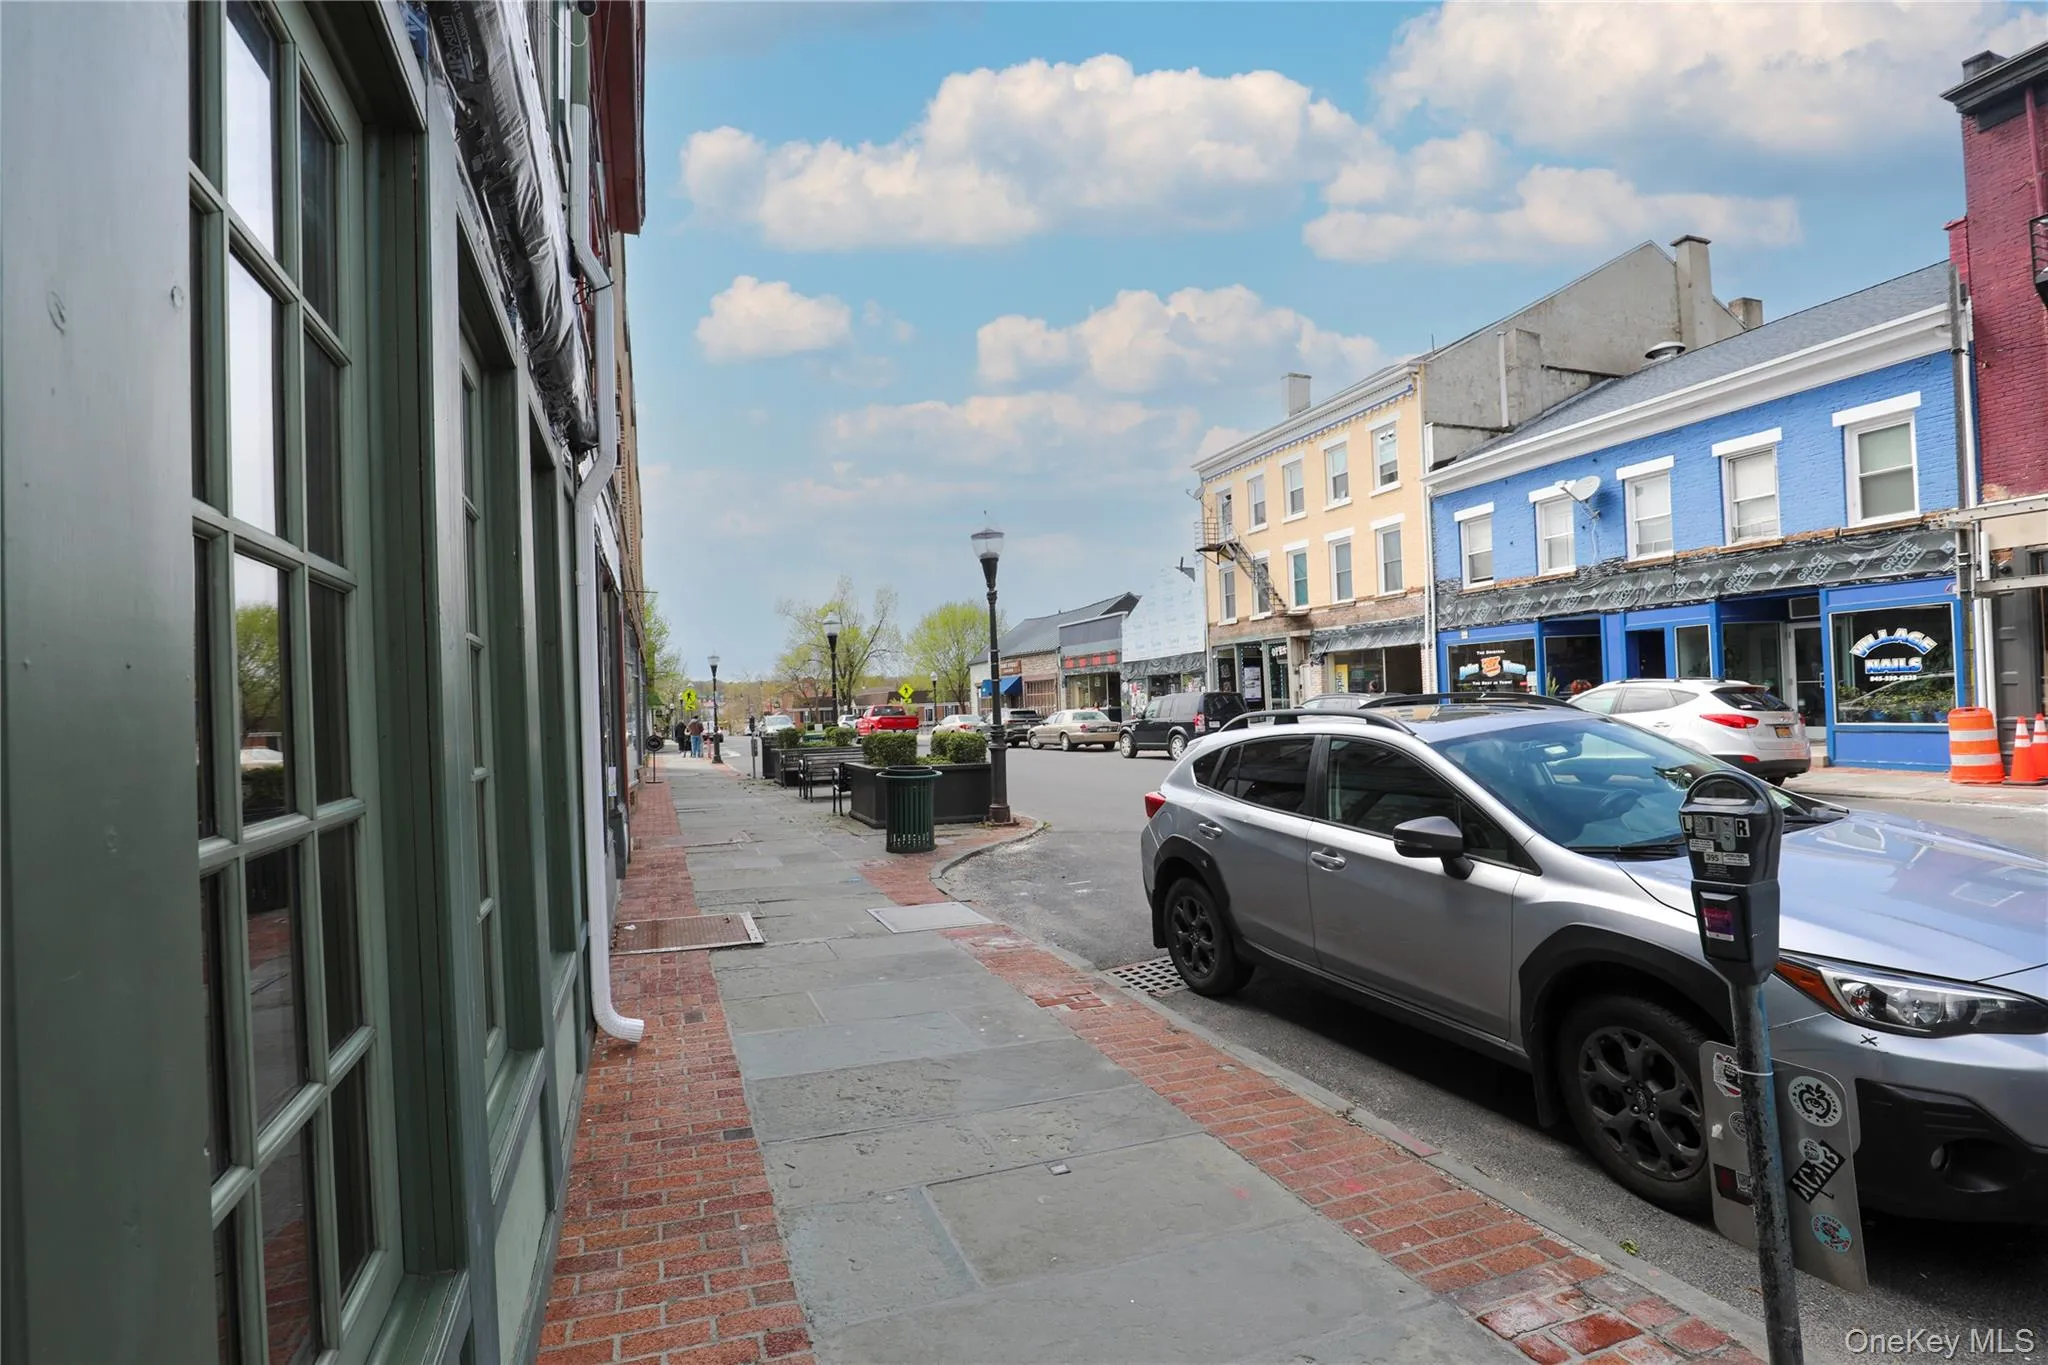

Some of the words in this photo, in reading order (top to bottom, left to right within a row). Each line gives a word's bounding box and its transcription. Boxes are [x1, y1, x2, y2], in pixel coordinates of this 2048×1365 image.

[1797, 552, 1825, 582] GRACE
[1881, 540, 1912, 572] GRACE
[1724, 563, 1749, 590] GRACE
[1849, 627, 1938, 658] VILLAGE
[1864, 656, 1923, 674] NAILS
[1737, 820, 1748, 836] R
